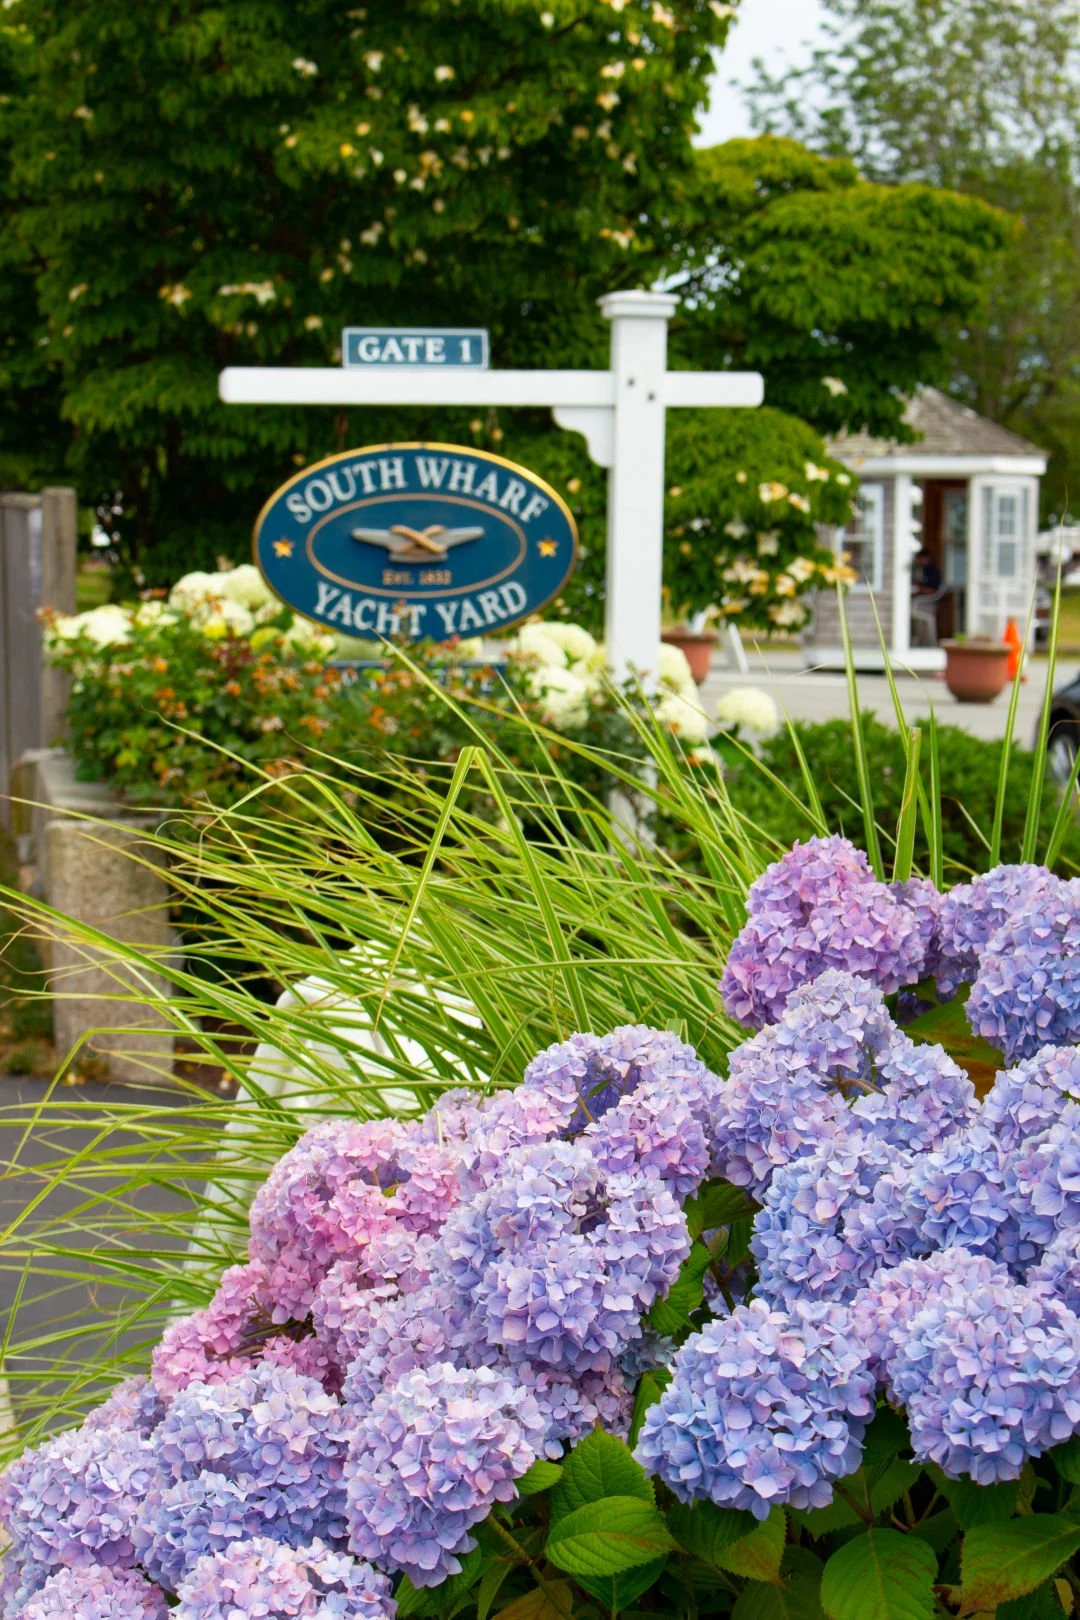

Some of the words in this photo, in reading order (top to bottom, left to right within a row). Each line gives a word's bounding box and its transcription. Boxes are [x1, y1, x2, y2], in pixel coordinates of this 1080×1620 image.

[358, 337, 446, 362] GATE
[460, 338, 473, 362] 1
[287, 458, 407, 523] SOUTH
[415, 457, 548, 522] WHARF
[314, 581, 427, 635] YACHT
[435, 581, 527, 634] YARD
